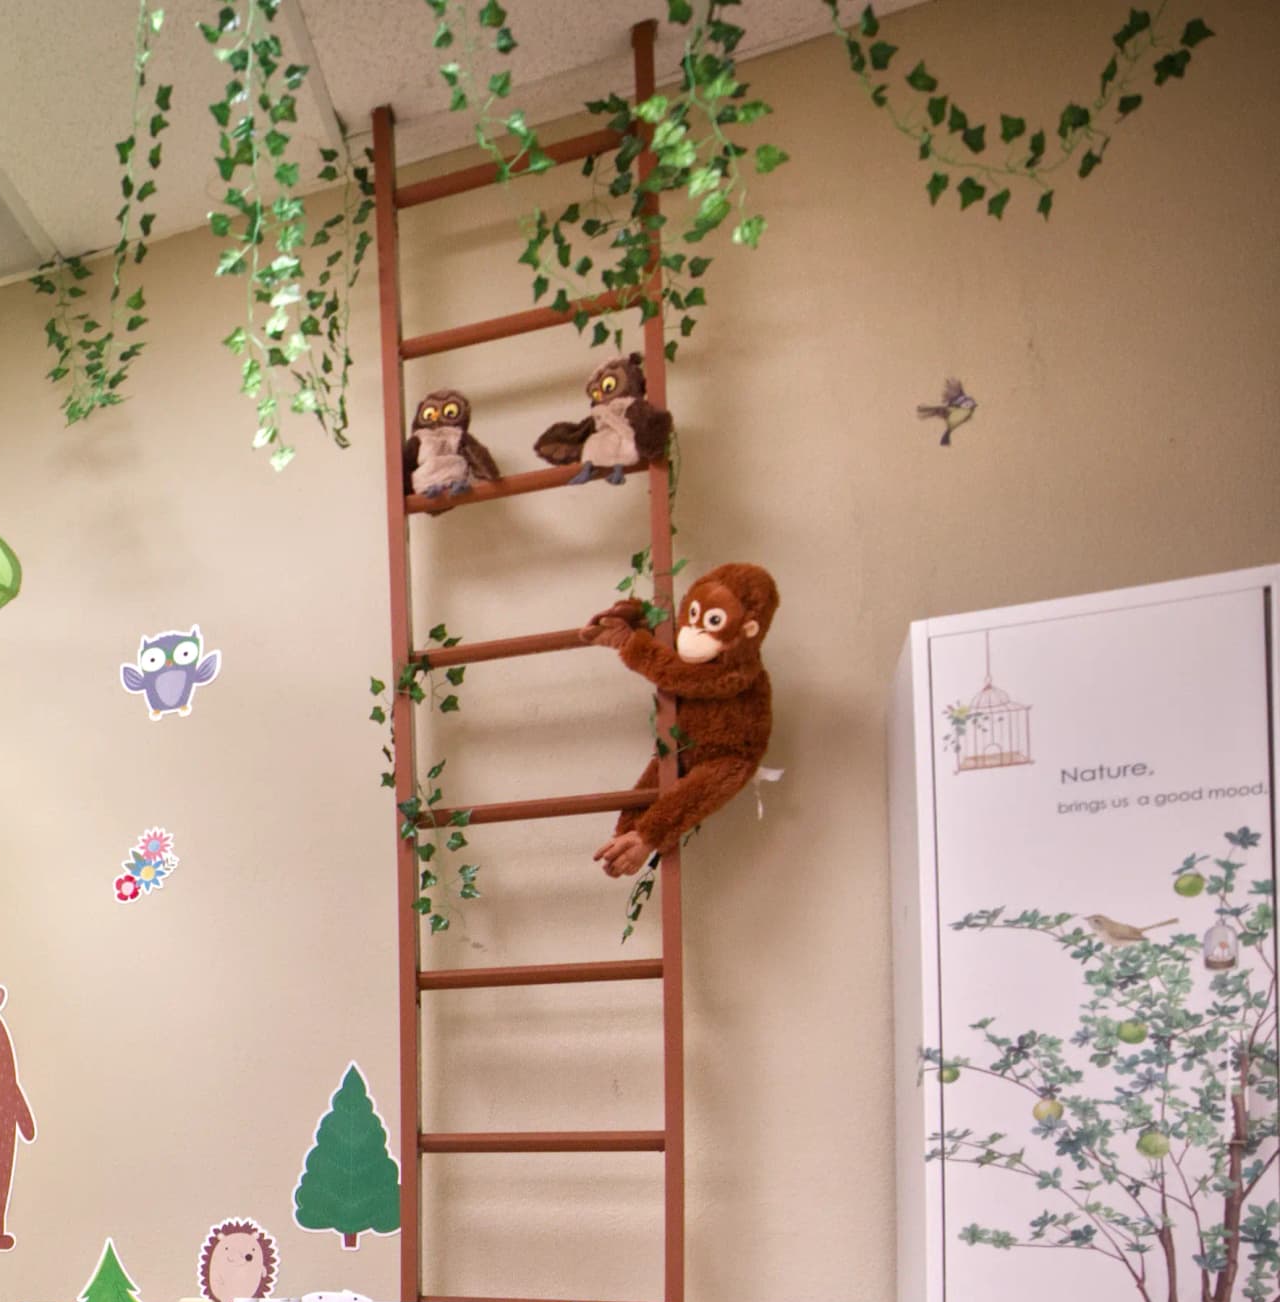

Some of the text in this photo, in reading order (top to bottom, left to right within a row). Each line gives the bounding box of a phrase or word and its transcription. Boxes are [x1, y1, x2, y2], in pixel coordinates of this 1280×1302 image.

[1057, 799, 1107, 815] brings
[1111, 796, 1129, 809] us
[1137, 795, 1149, 806] a
[1154, 788, 1203, 807] good
